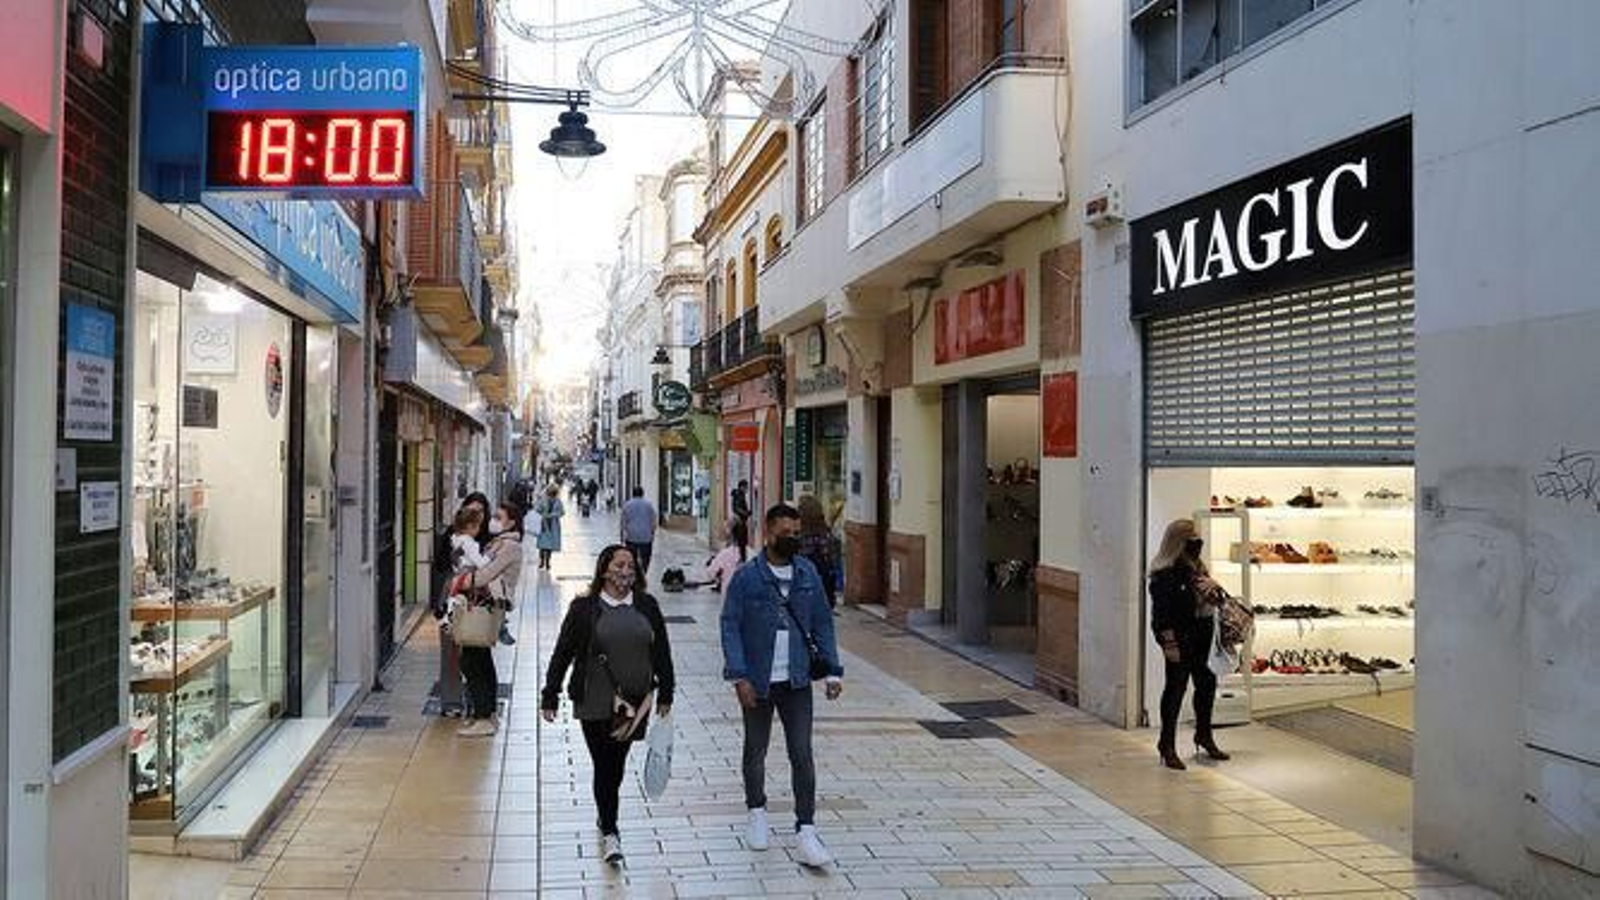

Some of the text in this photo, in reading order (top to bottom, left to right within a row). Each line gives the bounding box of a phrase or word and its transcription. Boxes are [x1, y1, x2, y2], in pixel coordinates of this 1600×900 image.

[312, 62, 408, 92] urbano
[238, 118, 406, 183] 18:00
[1151, 156, 1368, 296] MAGIC
